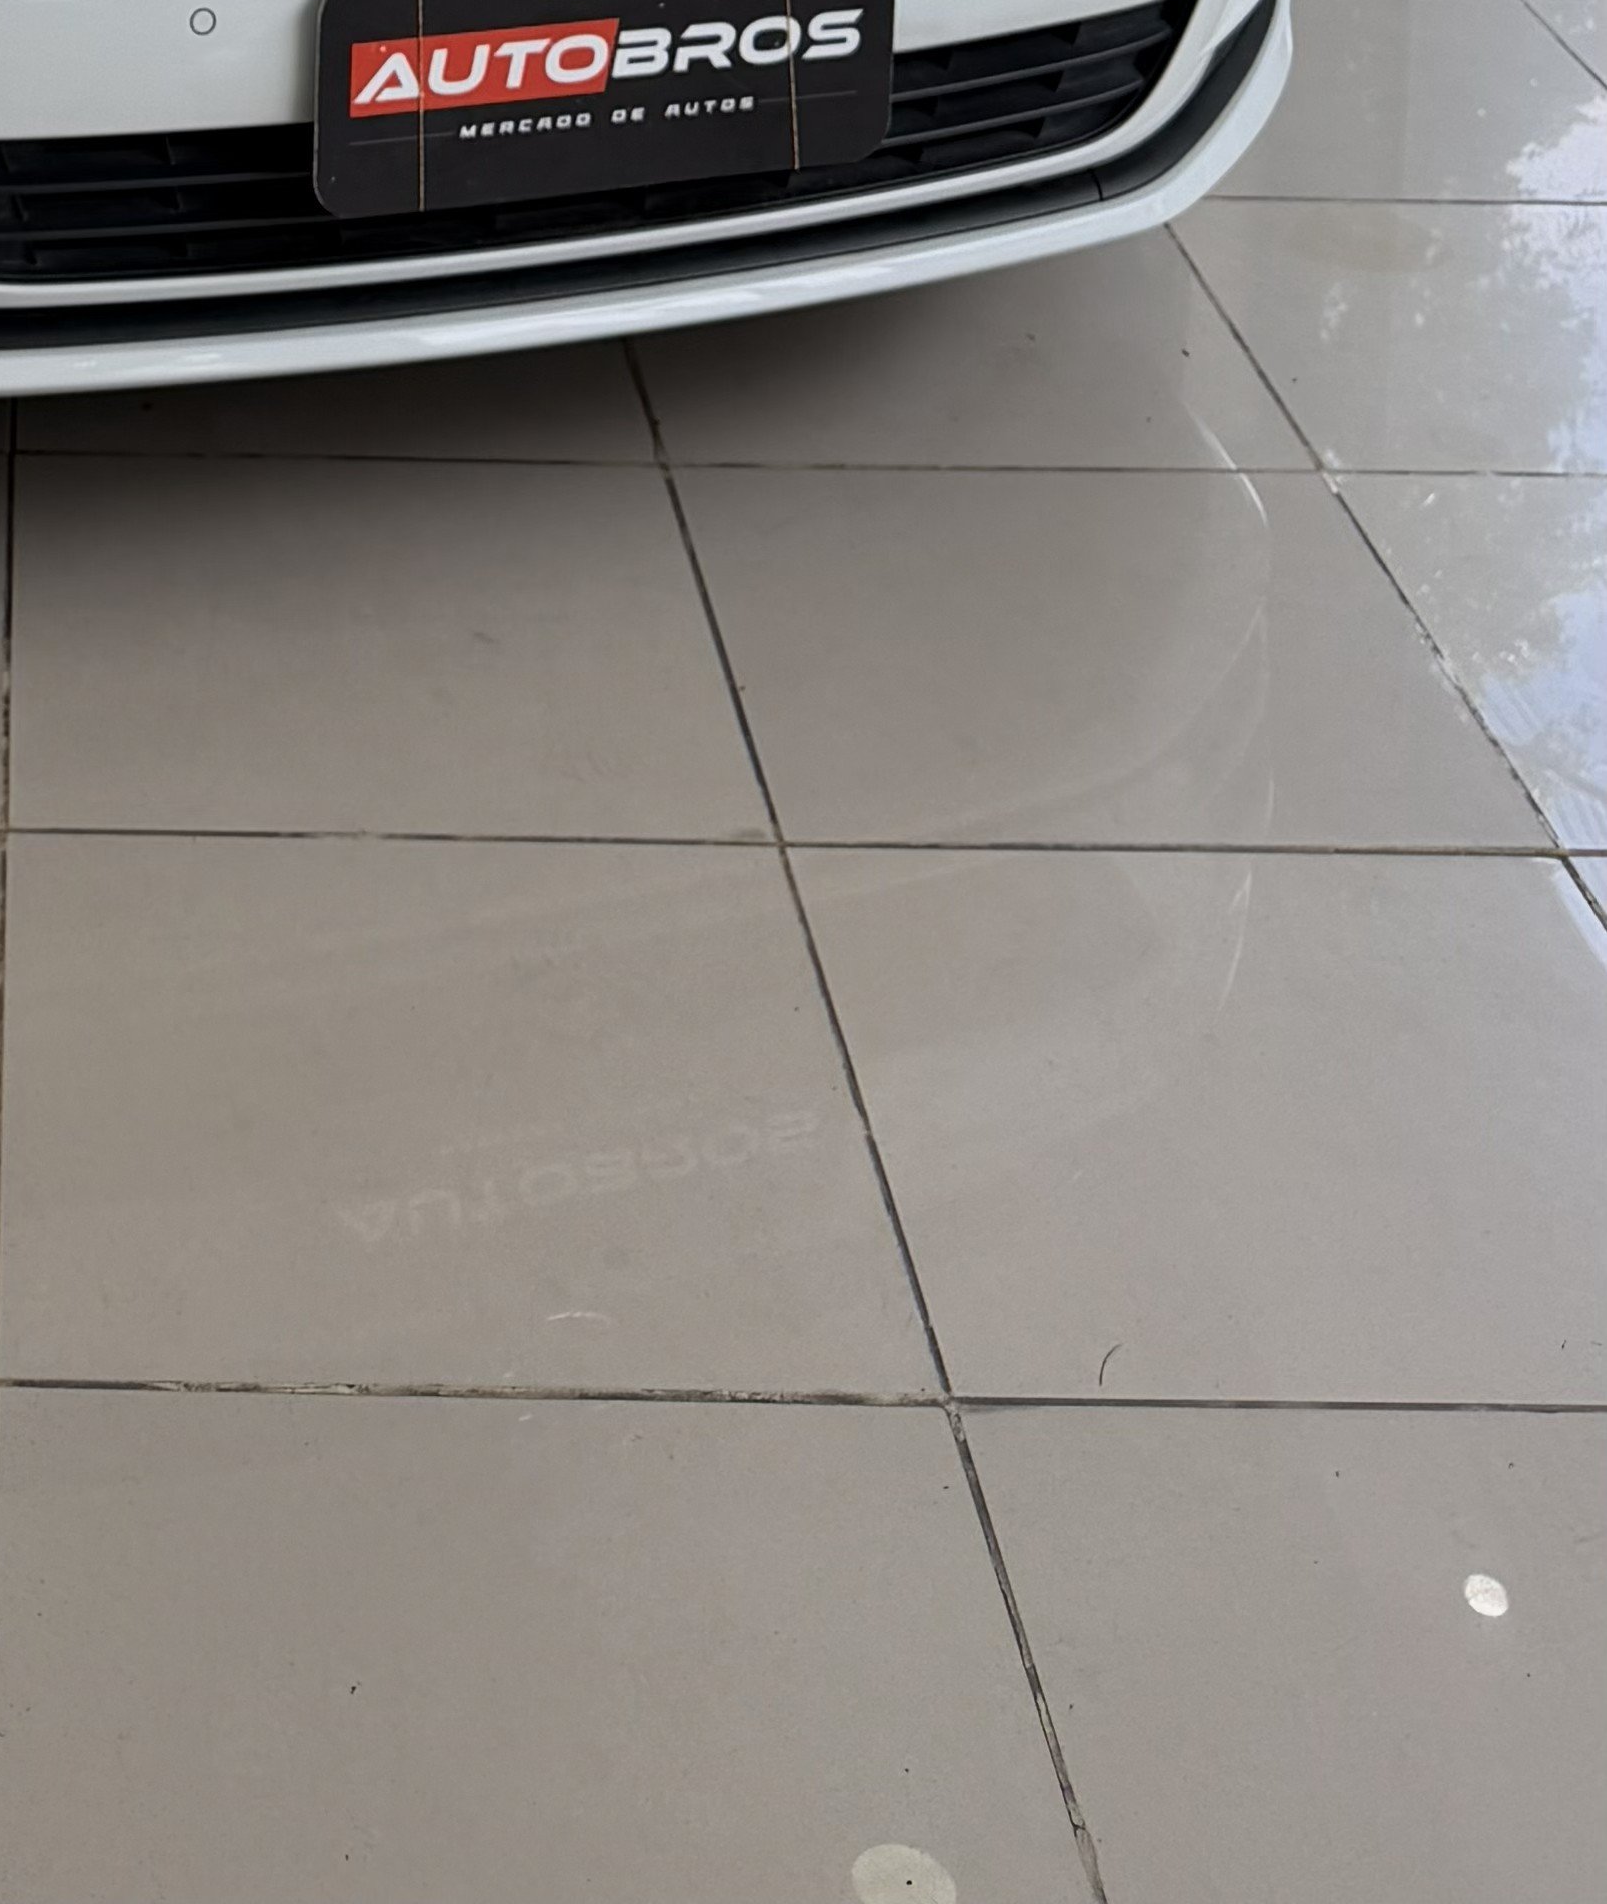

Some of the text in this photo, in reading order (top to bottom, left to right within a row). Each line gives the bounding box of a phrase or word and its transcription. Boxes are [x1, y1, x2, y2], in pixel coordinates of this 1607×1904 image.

[352, 8, 864, 105] AUTOBROS
[459, 95, 755, 139] MERCADO DE AUTOS
